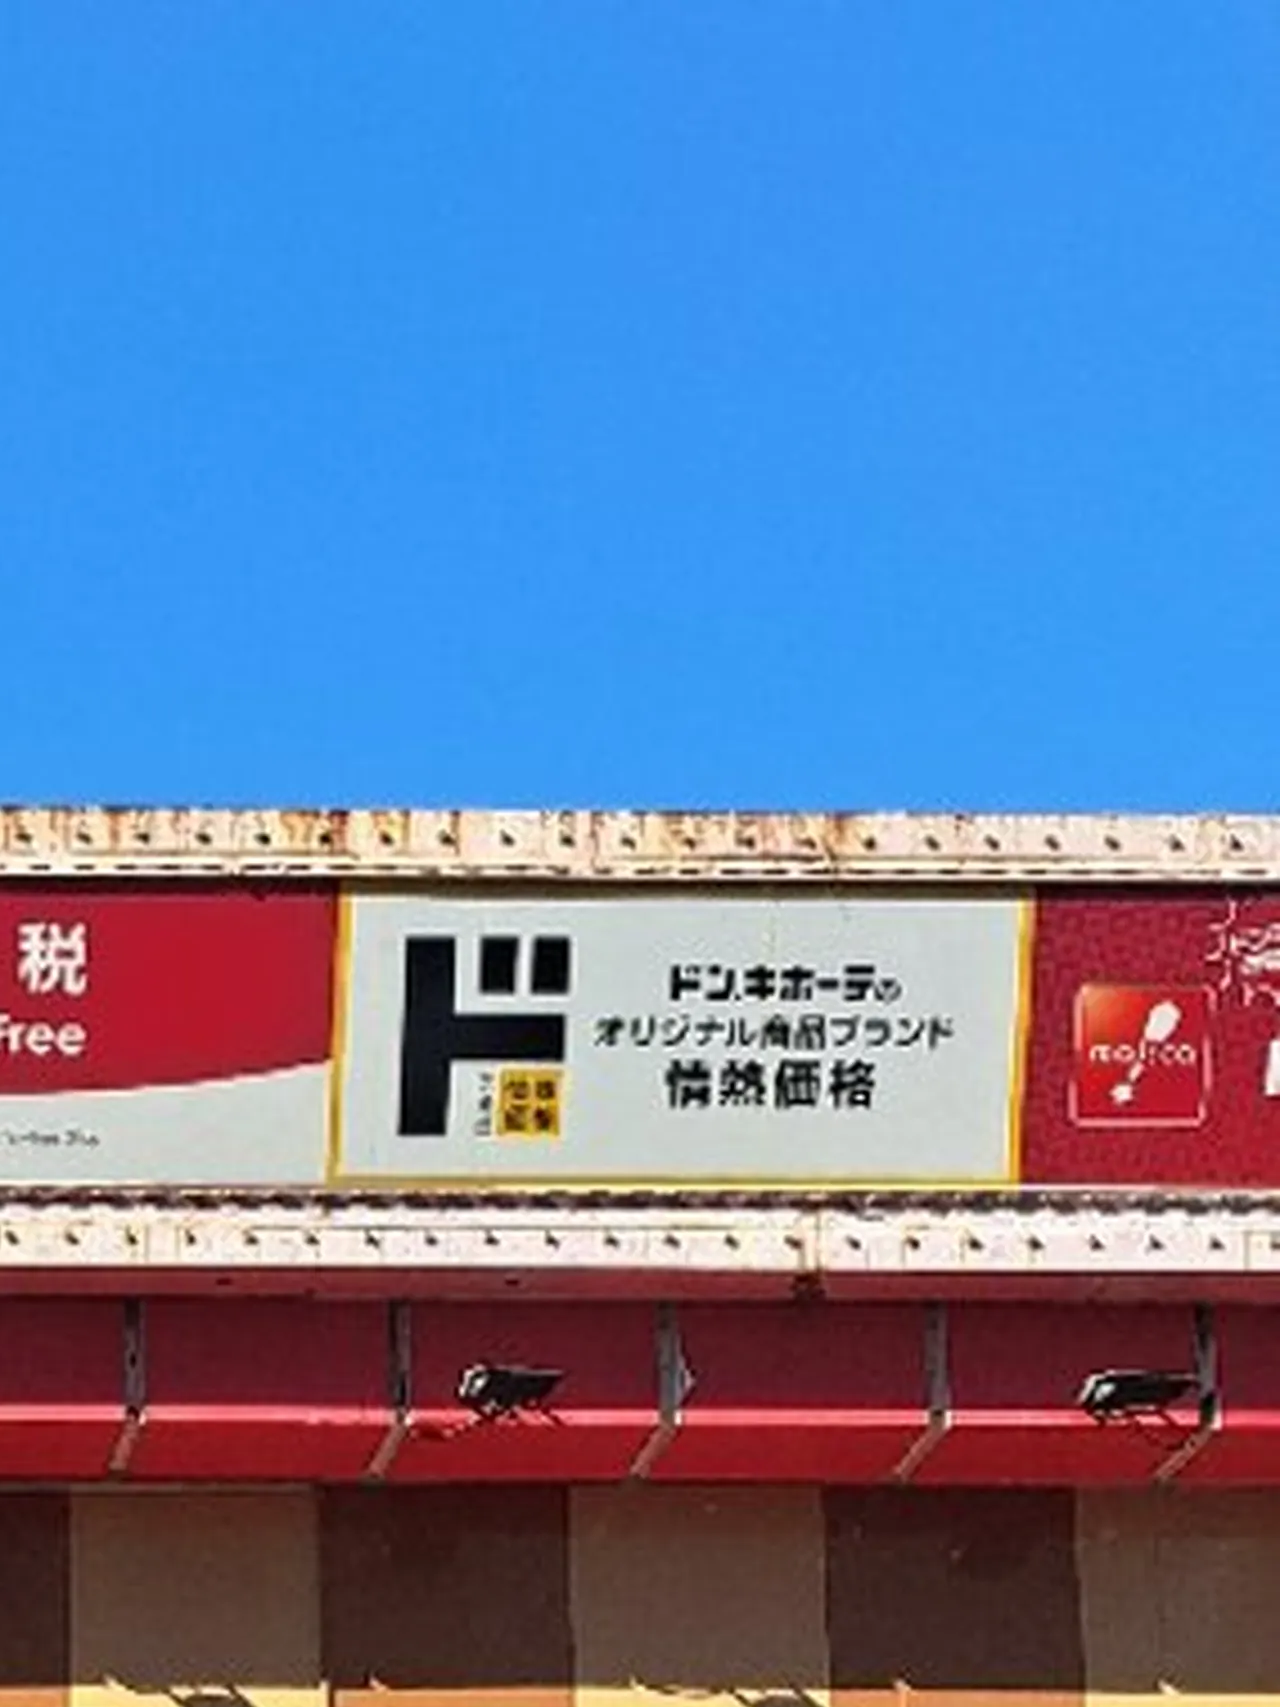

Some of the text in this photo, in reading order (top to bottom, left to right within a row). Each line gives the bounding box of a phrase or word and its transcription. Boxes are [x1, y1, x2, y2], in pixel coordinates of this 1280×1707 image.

[594, 1013, 954, 1051] オリジナル商品ブランド
[665, 1058, 877, 1110] 情熱価格
